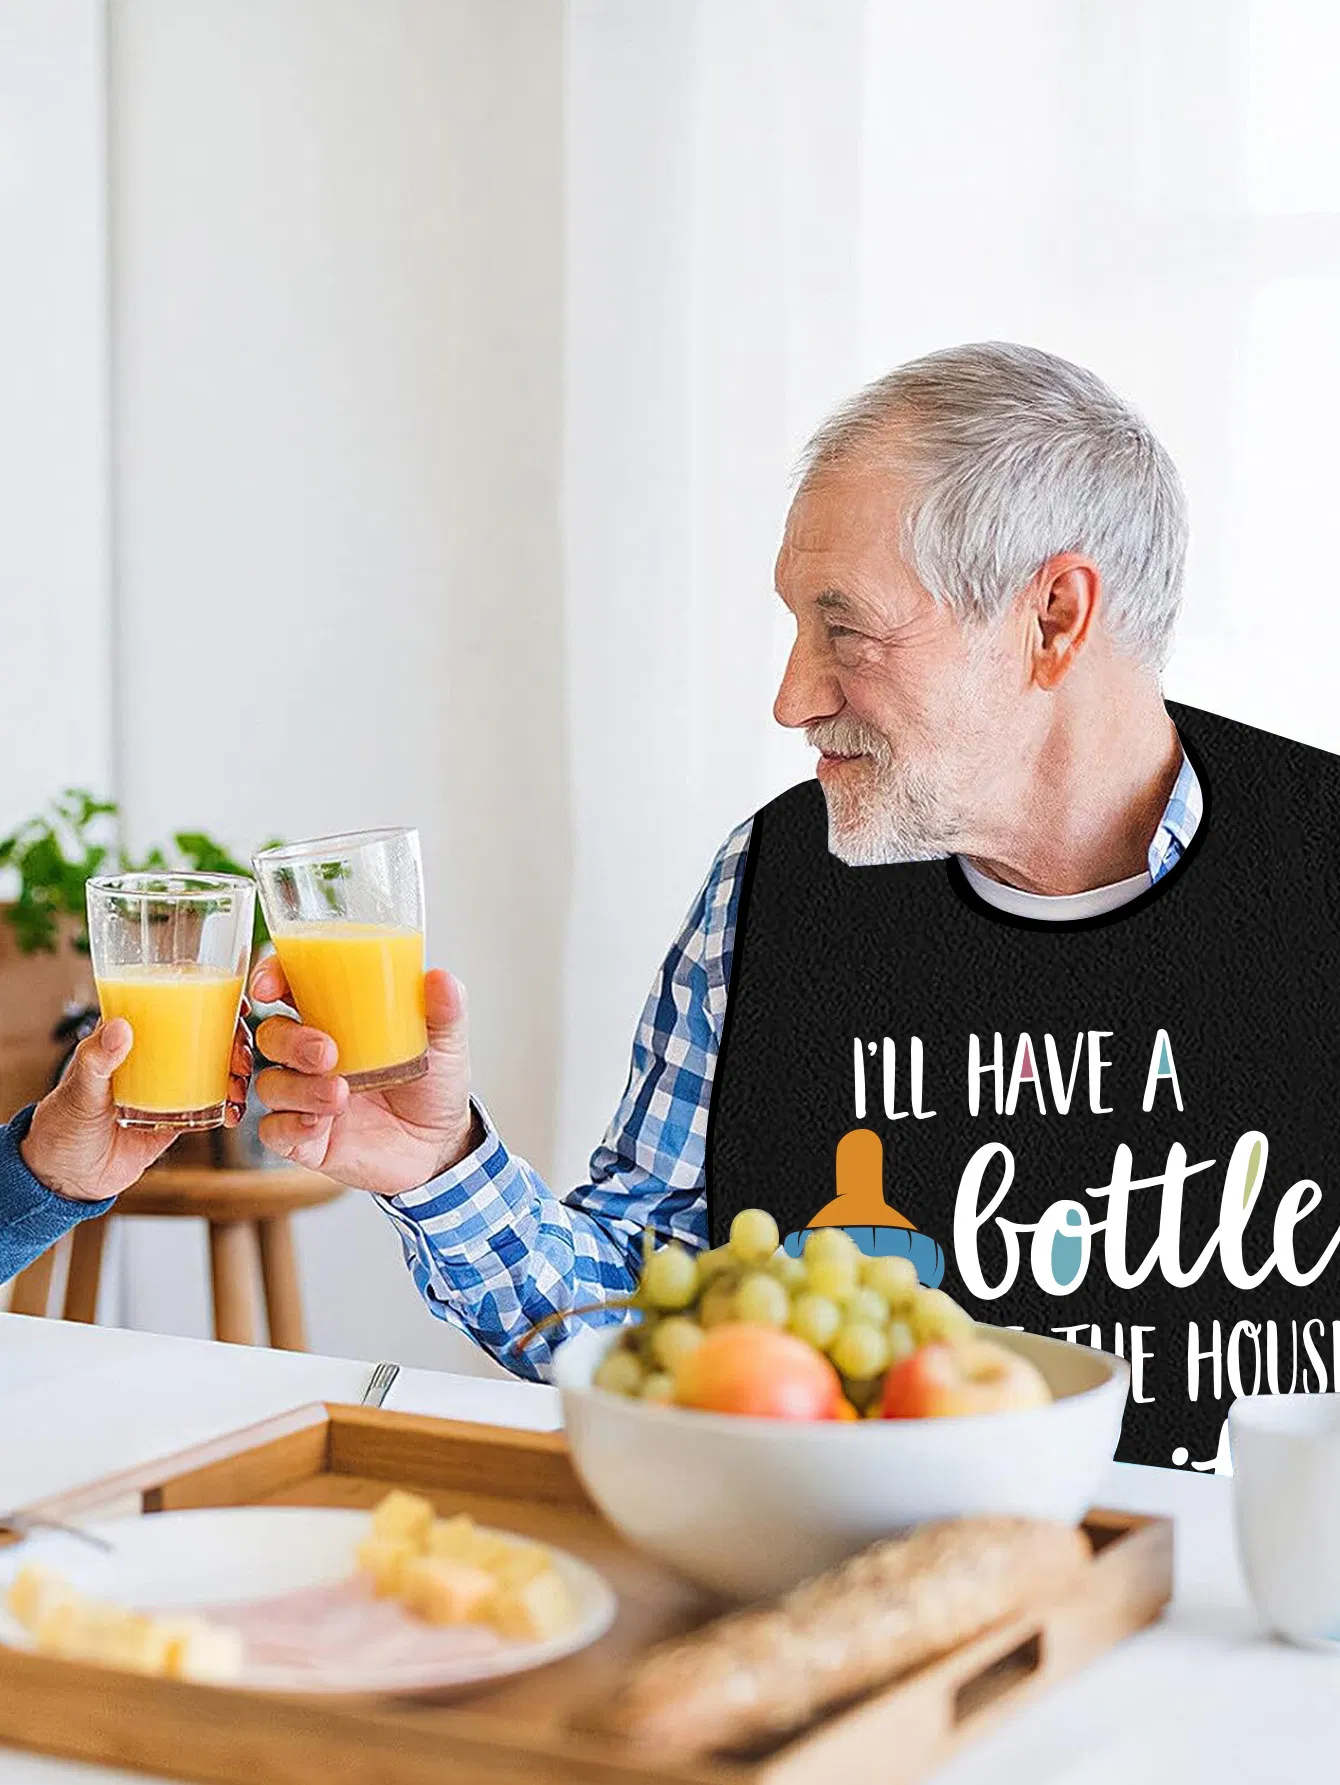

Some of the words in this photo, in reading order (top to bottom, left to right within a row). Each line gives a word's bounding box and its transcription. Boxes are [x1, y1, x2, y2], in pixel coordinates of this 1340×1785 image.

[853, 1036, 937, 1119] I'LL
[968, 1030, 1114, 1117] HAVE
[1143, 1029, 1184, 1112] A
[954, 1131, 1340, 1300] bottle
